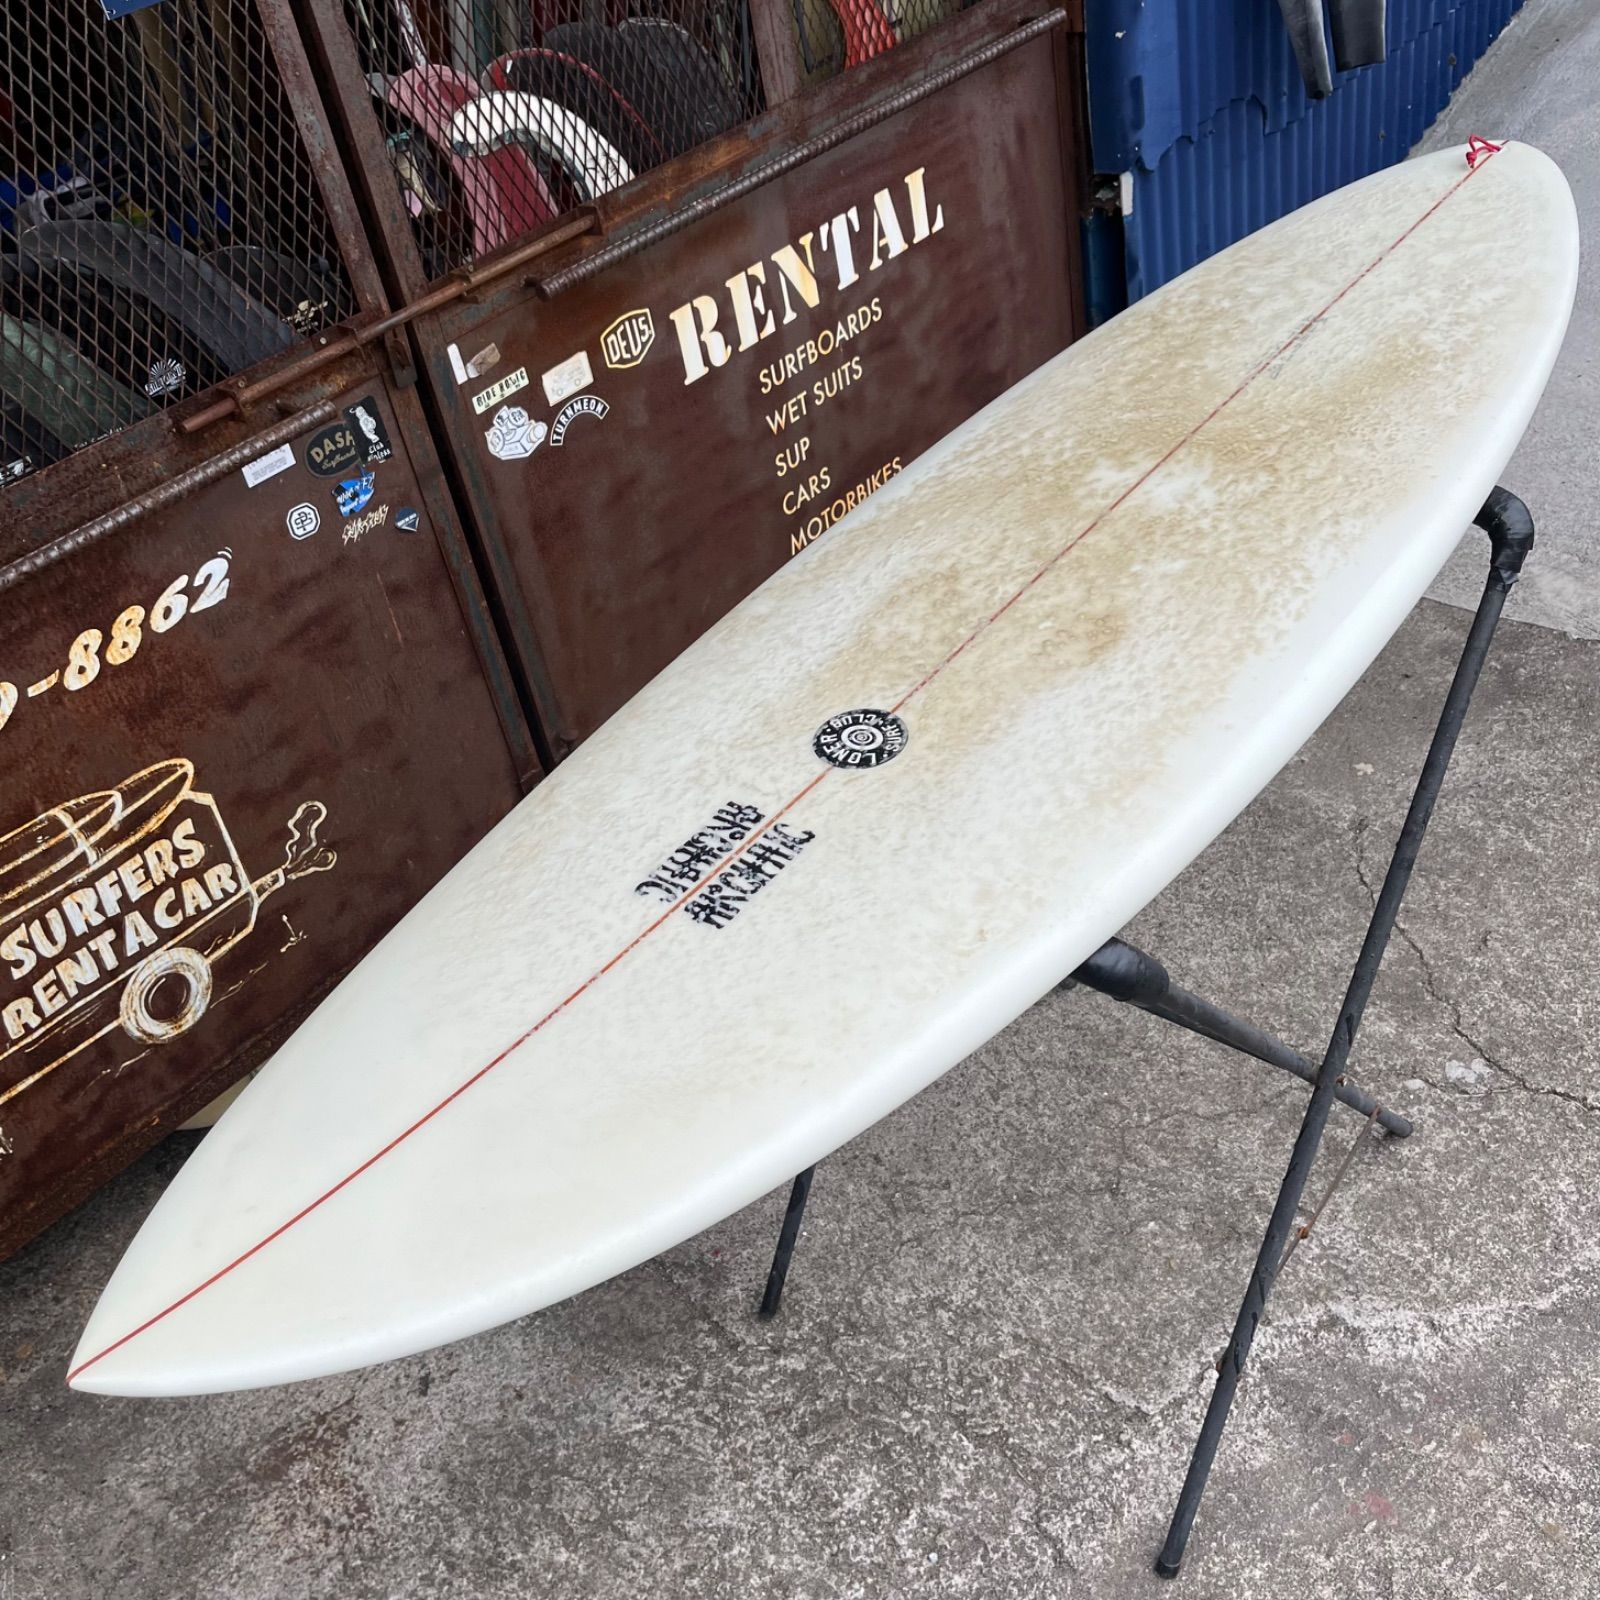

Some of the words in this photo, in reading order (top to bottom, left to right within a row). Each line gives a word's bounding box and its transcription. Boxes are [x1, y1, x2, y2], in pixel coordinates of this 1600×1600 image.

[669, 167, 944, 386] RENTAL
[607, 316, 650, 363] DEUS
[759, 297, 883, 394] SURFBOARDS
[765, 391, 808, 436] WET
[814, 356, 863, 406] SUITS
[775, 437, 810, 477] SUP
[782, 466, 831, 515] CARS
[790, 456, 902, 555] MOTORBIKES
[820, 733, 877, 764] LONER
[881, 724, 901, 752] SURF
[0, 818, 206, 980] SURFERS
[1, 928, 117, 1040] RENT
[124, 910, 158, 957] A
[153, 862, 238, 929] CAR
